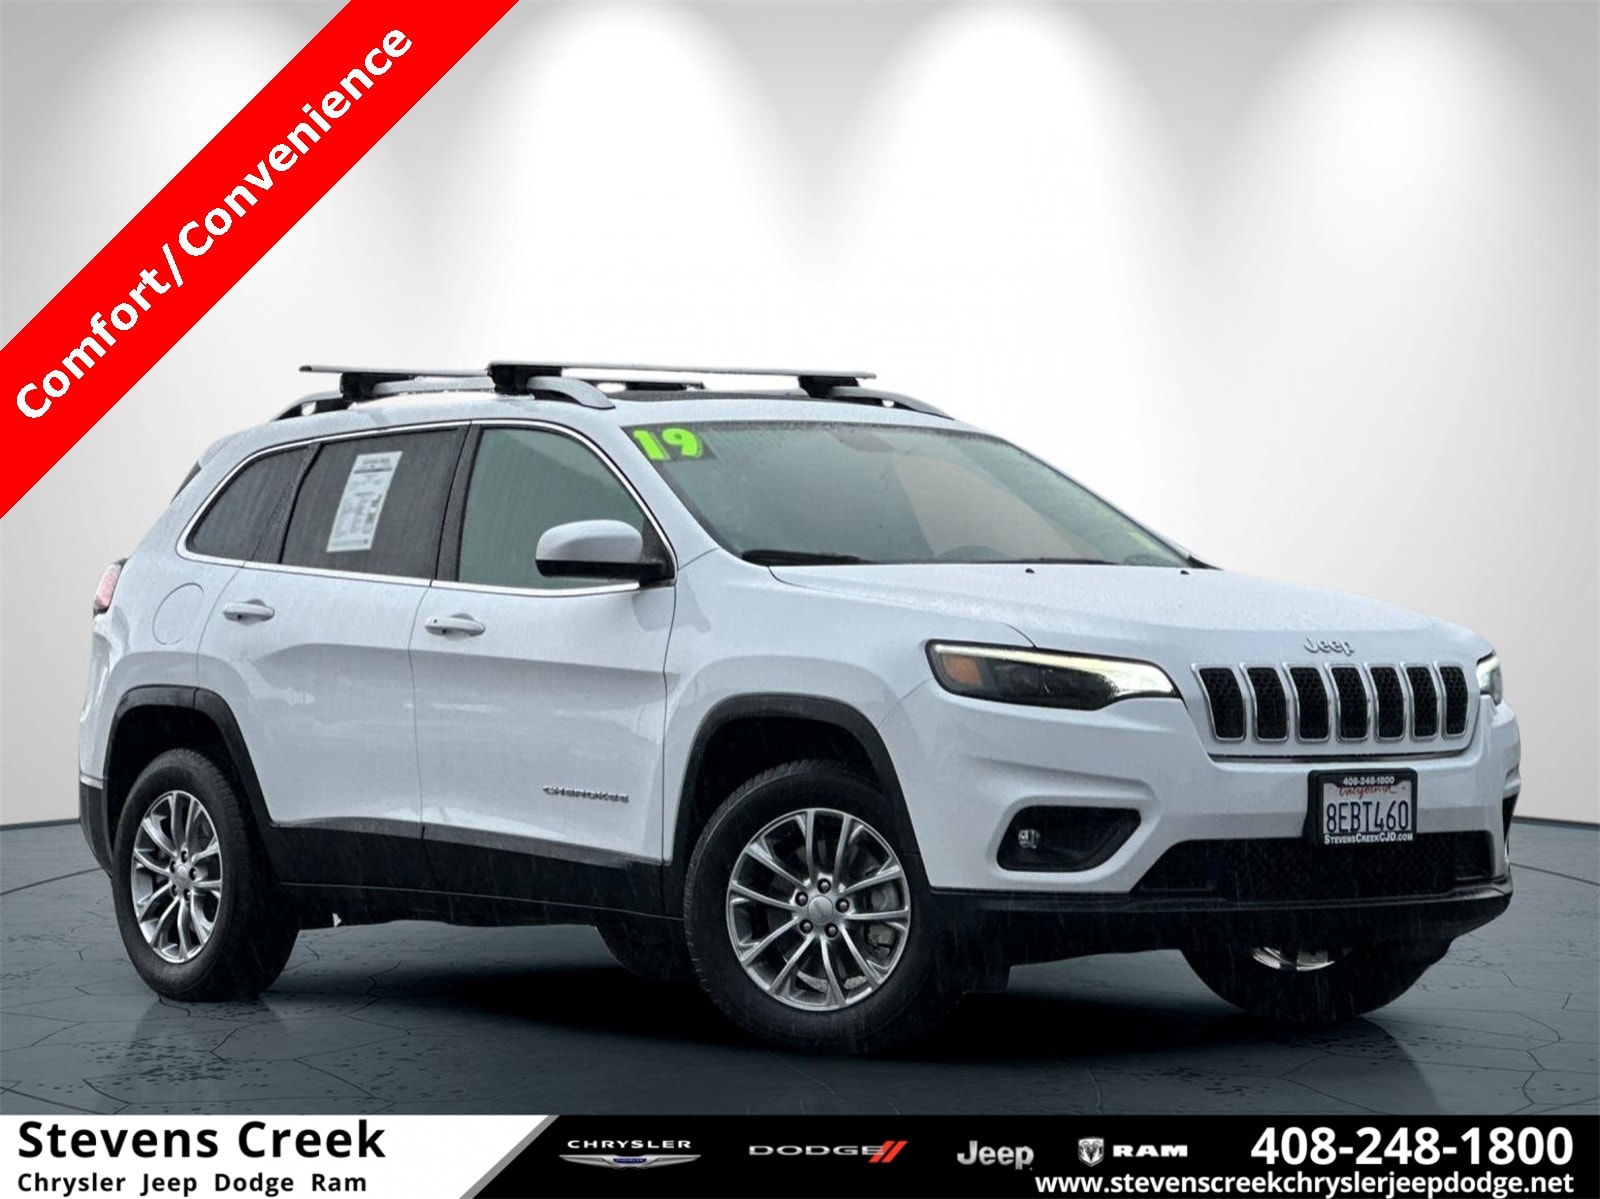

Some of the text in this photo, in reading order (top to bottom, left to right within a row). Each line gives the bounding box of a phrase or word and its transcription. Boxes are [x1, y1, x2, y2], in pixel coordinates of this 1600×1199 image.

[633, 427, 703, 460] 19
[1303, 635, 1355, 657] Jeep
[1343, 776, 1395, 786] 408-248-1800
[1326, 800, 1409, 833] 8EBT460
